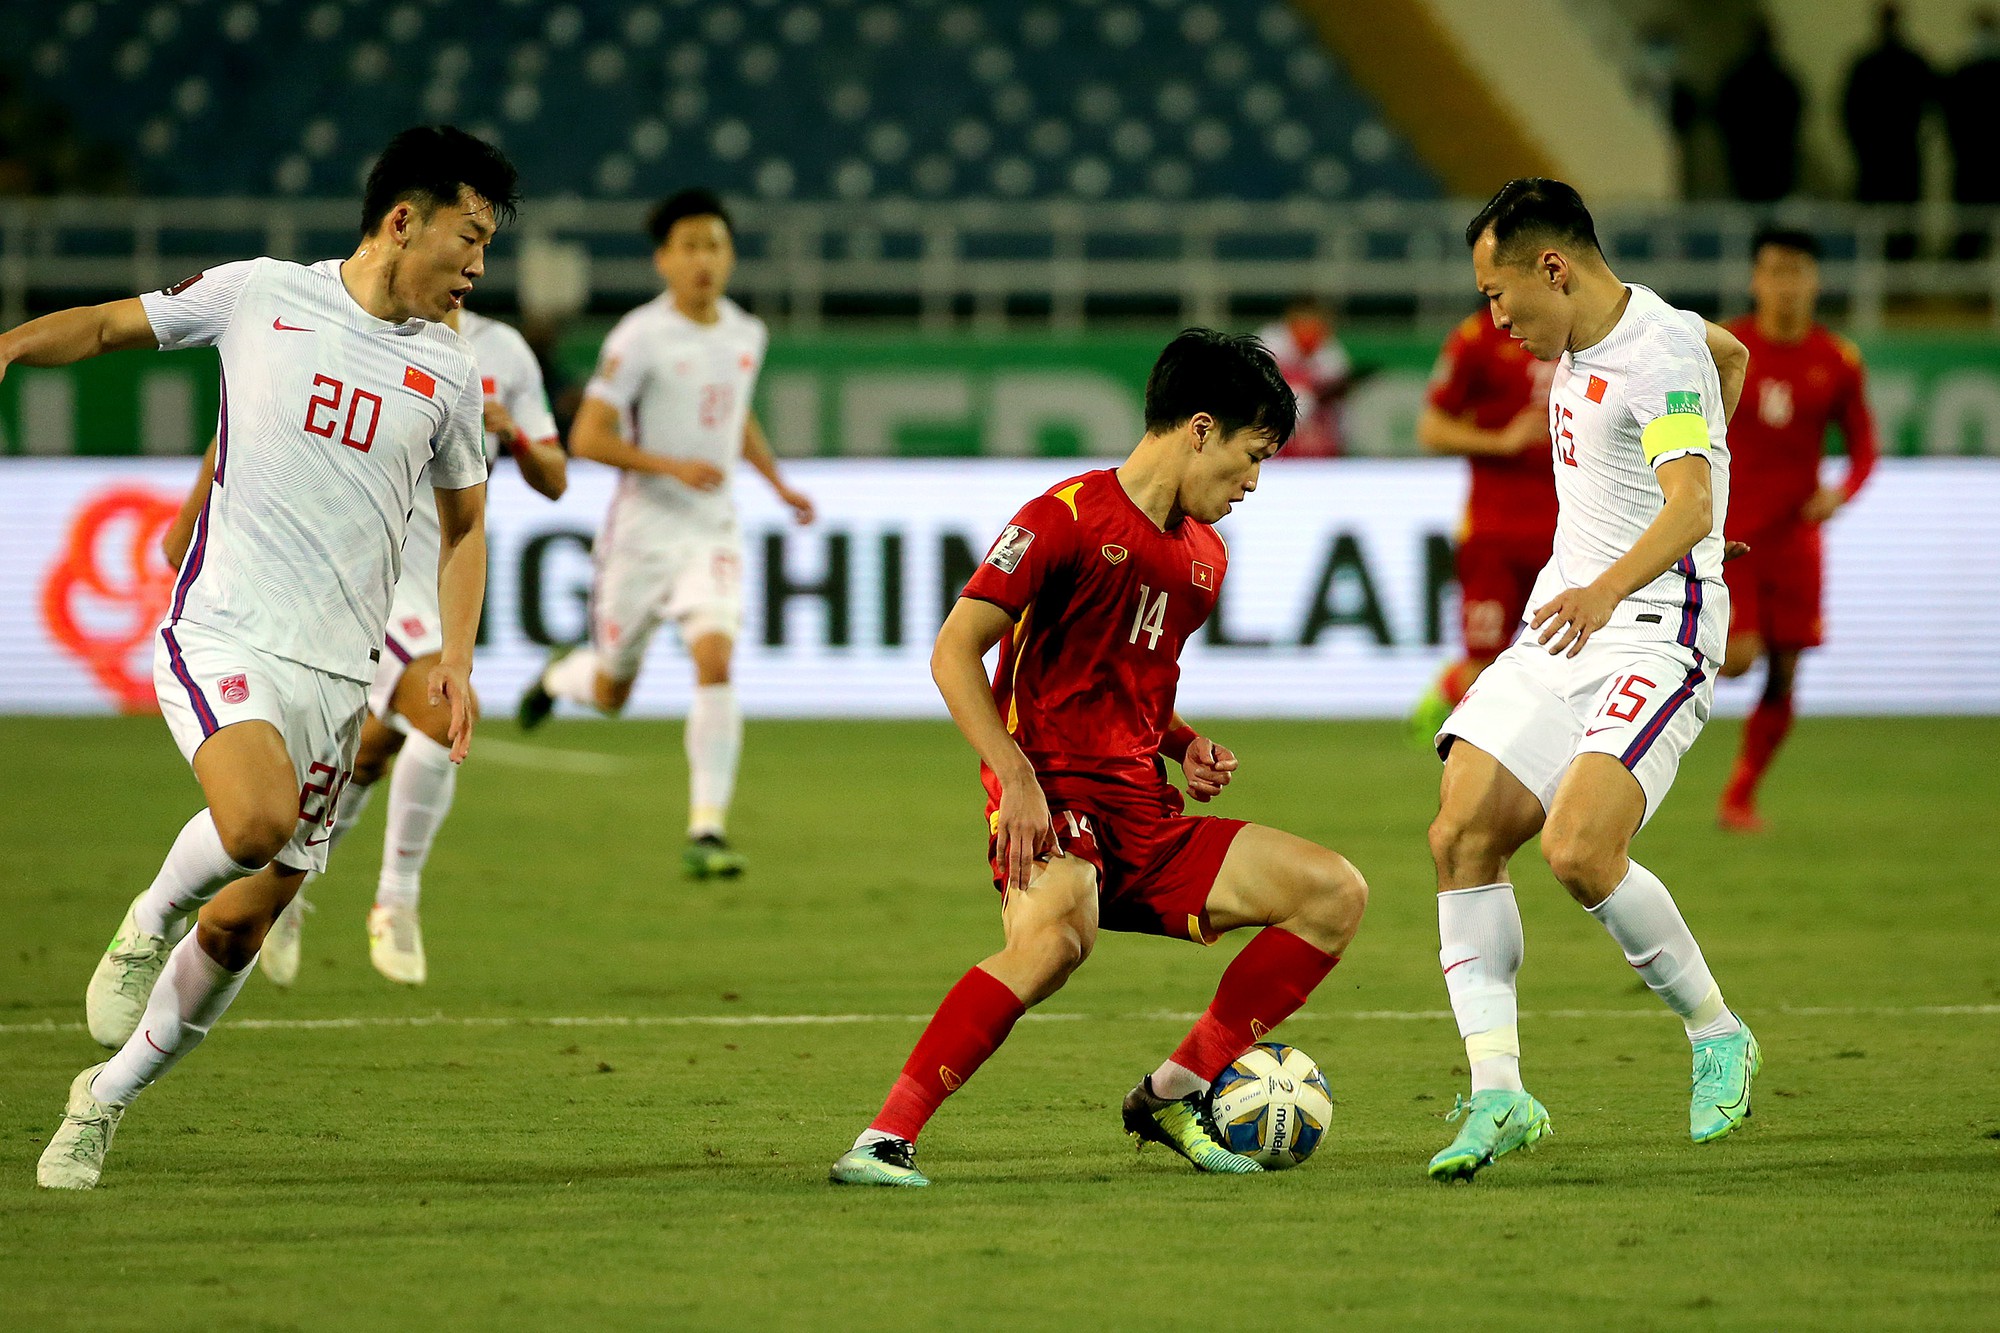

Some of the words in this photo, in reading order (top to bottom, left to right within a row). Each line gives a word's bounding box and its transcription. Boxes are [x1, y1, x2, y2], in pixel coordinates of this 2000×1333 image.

[304, 373, 382, 453] 20
[1554, 403, 1578, 467] 15
[1130, 583, 1168, 650] 14
[1595, 675, 1657, 723] 15
[1270, 1108, 1287, 1156] molten
